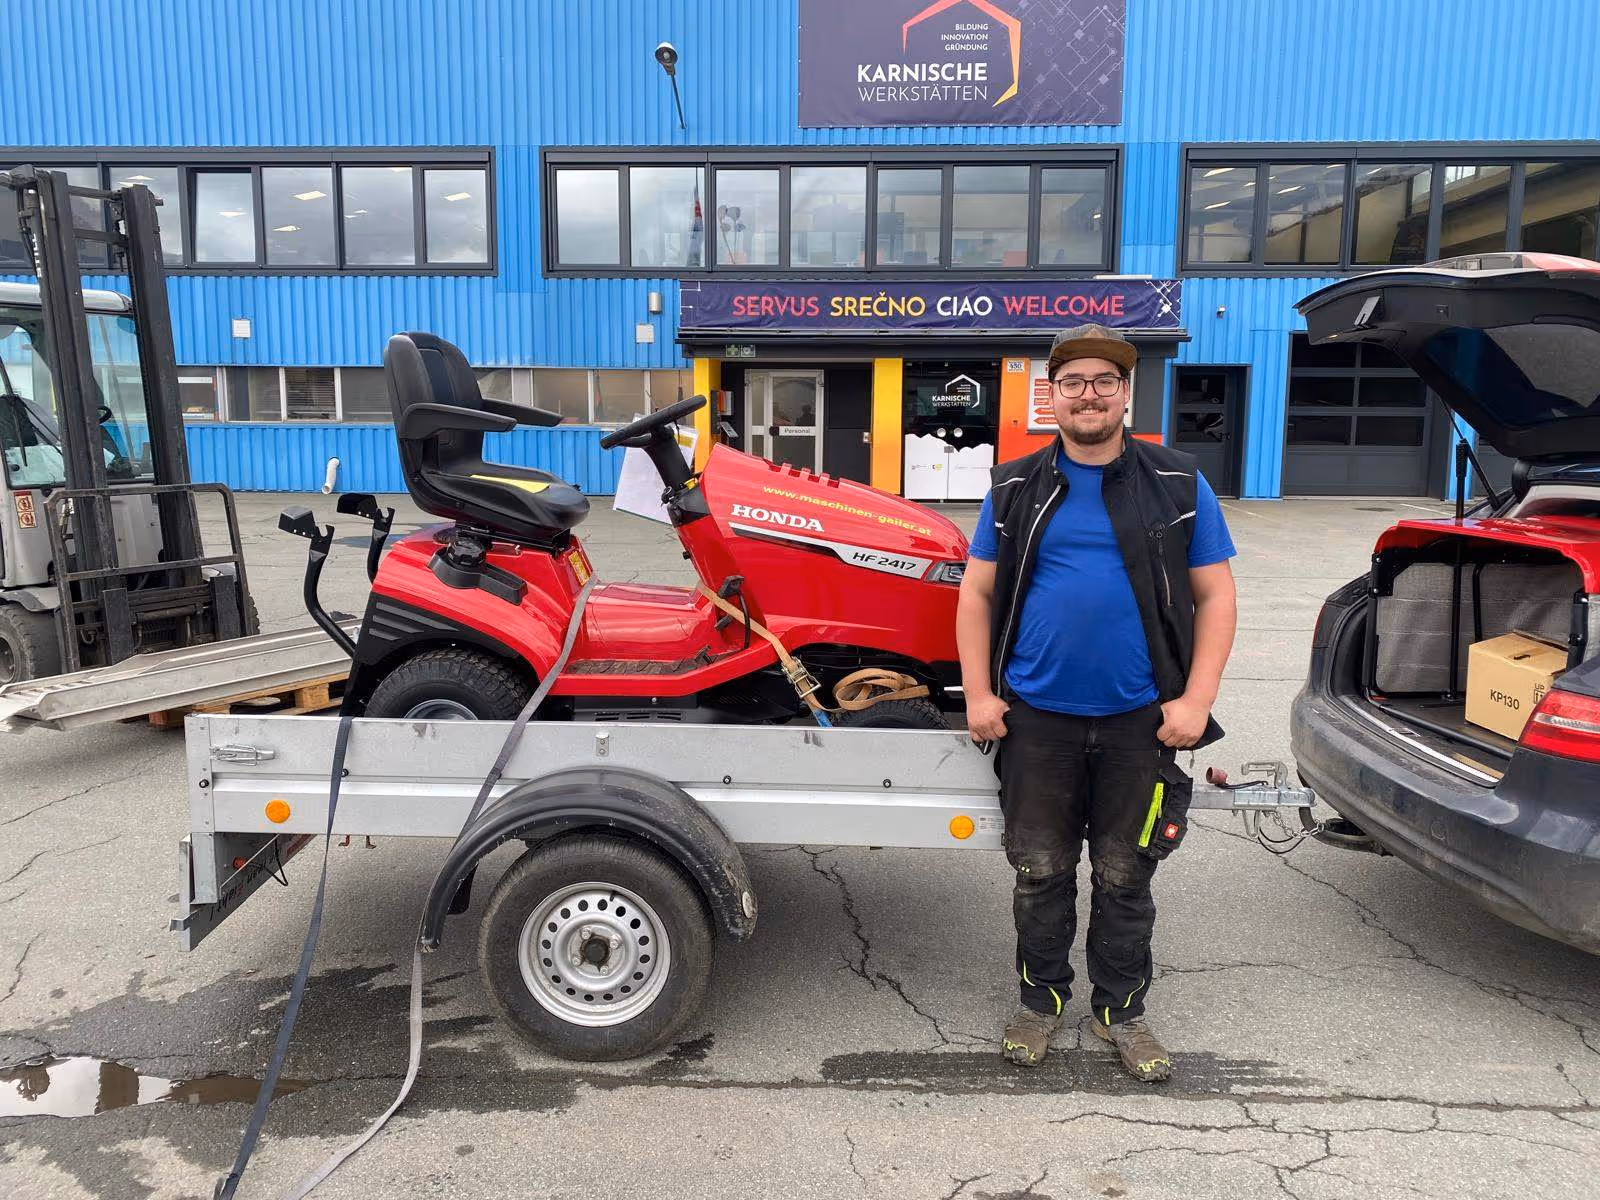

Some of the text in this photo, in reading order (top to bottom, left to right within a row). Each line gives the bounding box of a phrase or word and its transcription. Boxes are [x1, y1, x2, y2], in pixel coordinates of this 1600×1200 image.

[941, 33, 988, 41] INNOVATION
[955, 23, 988, 31] BILDUNG
[944, 43, 988, 51] GRÜNDUNG
[857, 62, 988, 83] KARNISCHE
[857, 83, 988, 102] WERKSTÄTTEN
[732, 291, 1125, 317] SERVUS SREČNO CIAO WELCOME
[730, 503, 825, 533] HONDA
[763, 486, 932, 536] www.maschinen-gailer.at
[852, 551, 917, 571] HF 2417
[1490, 689, 1520, 710] KP130
